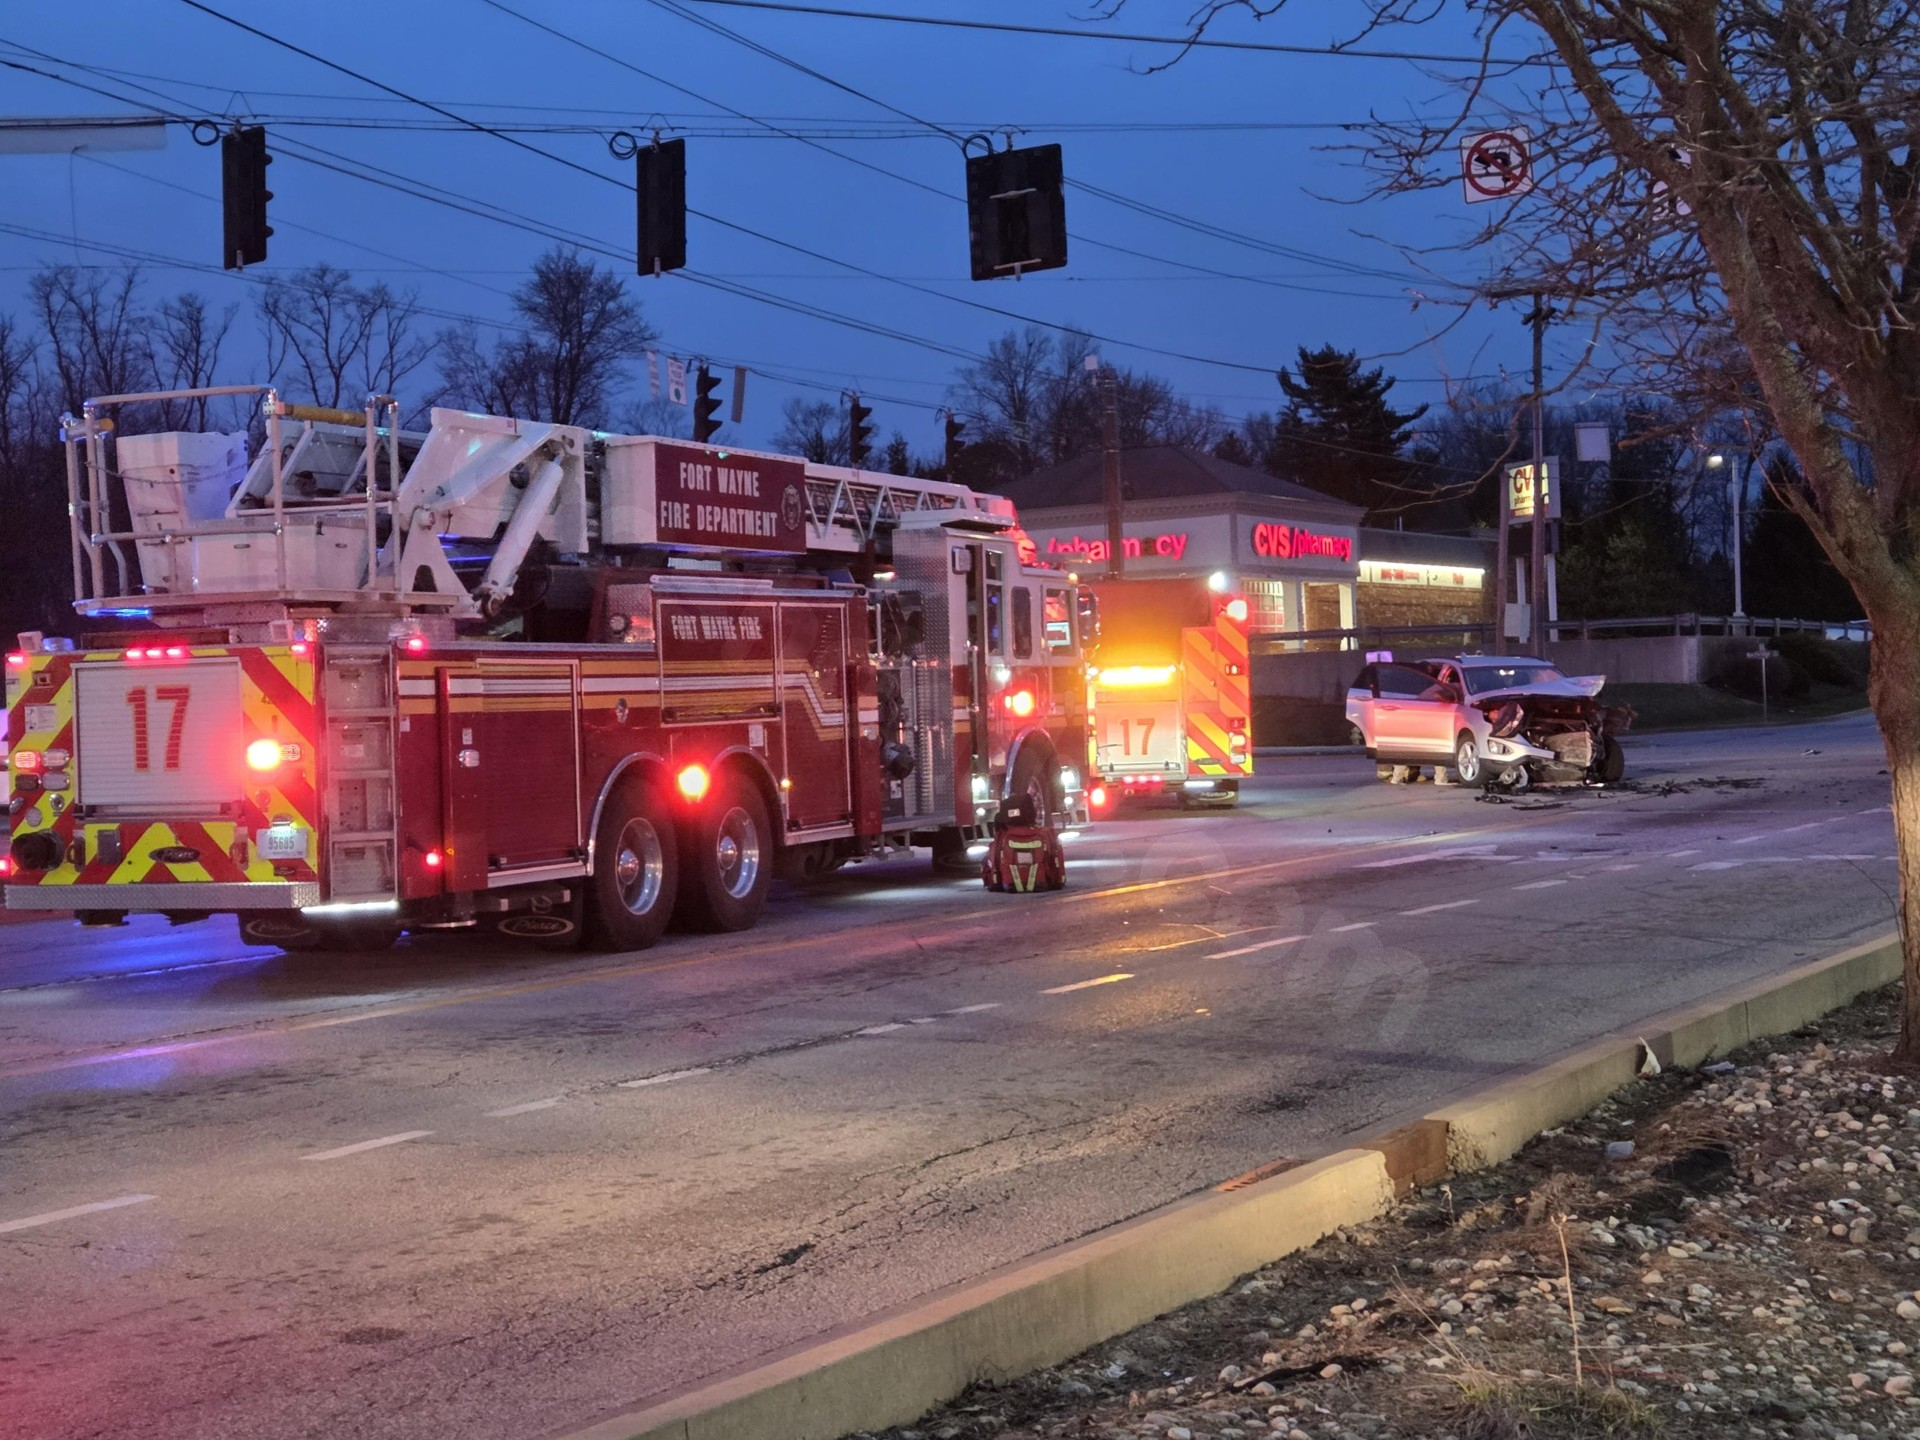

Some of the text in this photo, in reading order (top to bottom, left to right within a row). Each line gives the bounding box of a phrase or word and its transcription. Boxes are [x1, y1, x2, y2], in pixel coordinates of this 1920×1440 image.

[681, 462, 759, 497] FORT WAYNE
[1514, 468, 1534, 493] CV
[660, 501, 777, 537] FIRE DEPARTMENT
[1254, 523, 1352, 561] CVS/pharmacy
[671, 615, 762, 639] FORT WAYNE FIRE
[126, 685, 190, 772] 17
[1120, 718, 1155, 755] 17
